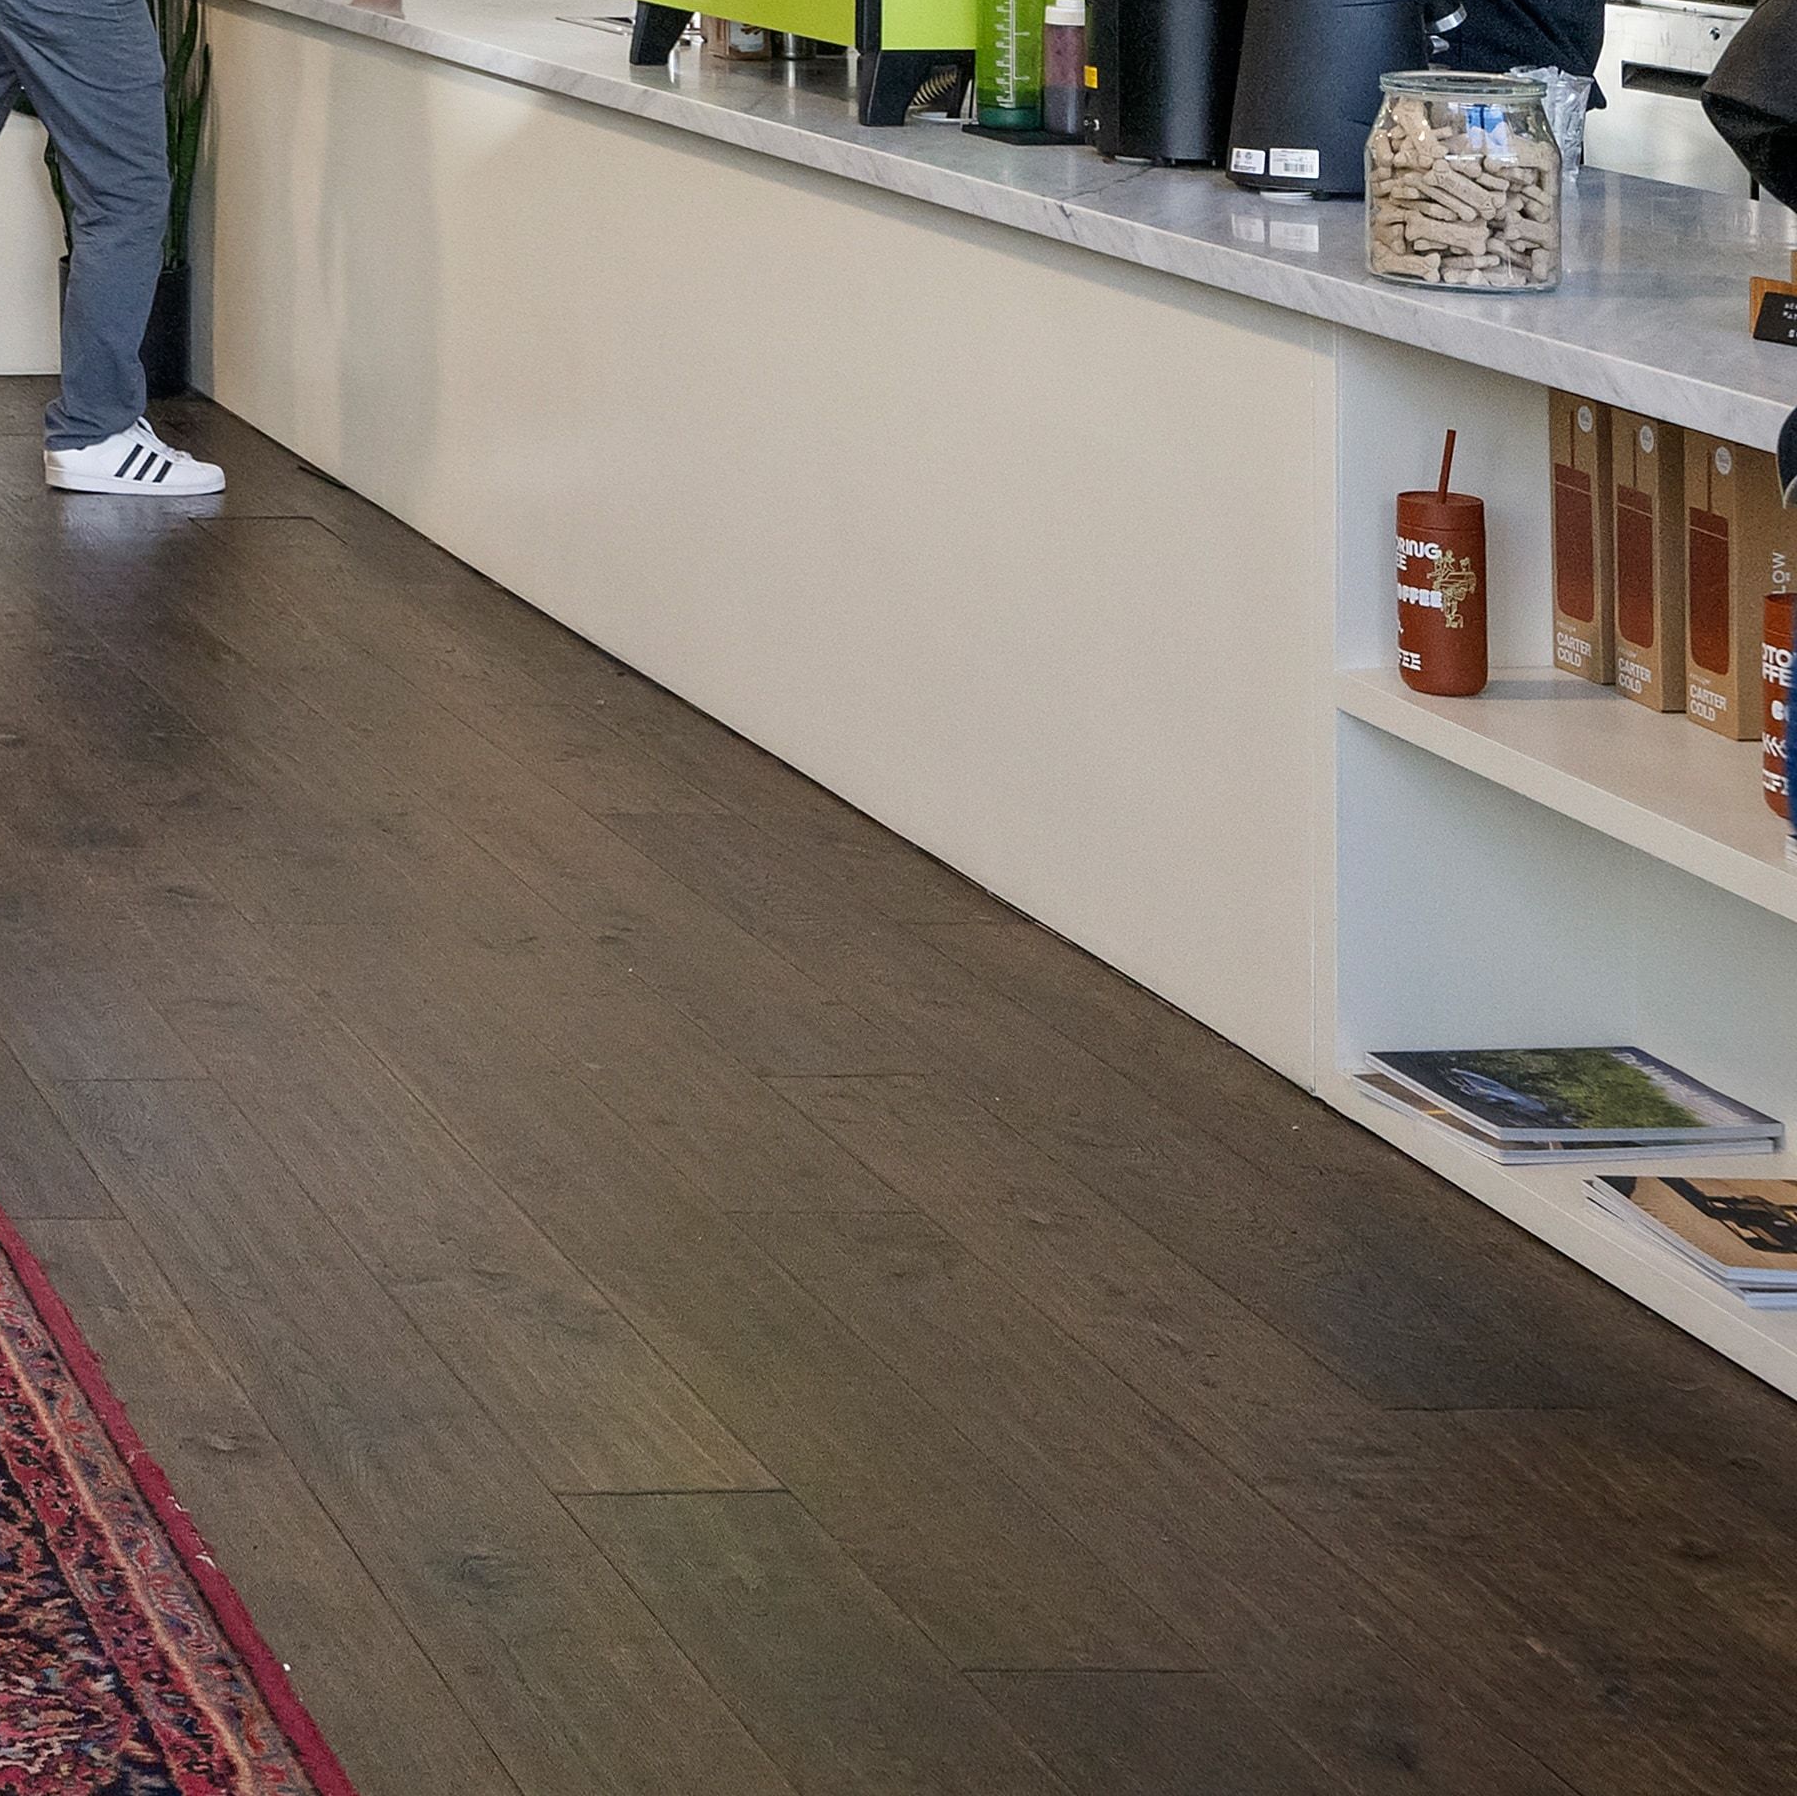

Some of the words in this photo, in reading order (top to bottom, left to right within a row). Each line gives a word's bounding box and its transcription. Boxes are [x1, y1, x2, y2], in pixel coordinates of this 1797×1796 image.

[1557, 631, 1592, 658] CARTER
[1557, 647, 1582, 668] COLD
[1618, 657, 1652, 684] CARTER
[1618, 673, 1643, 695] COLD
[1689, 684, 1728, 712] CARTER
[1689, 699, 1716, 722] COLD
